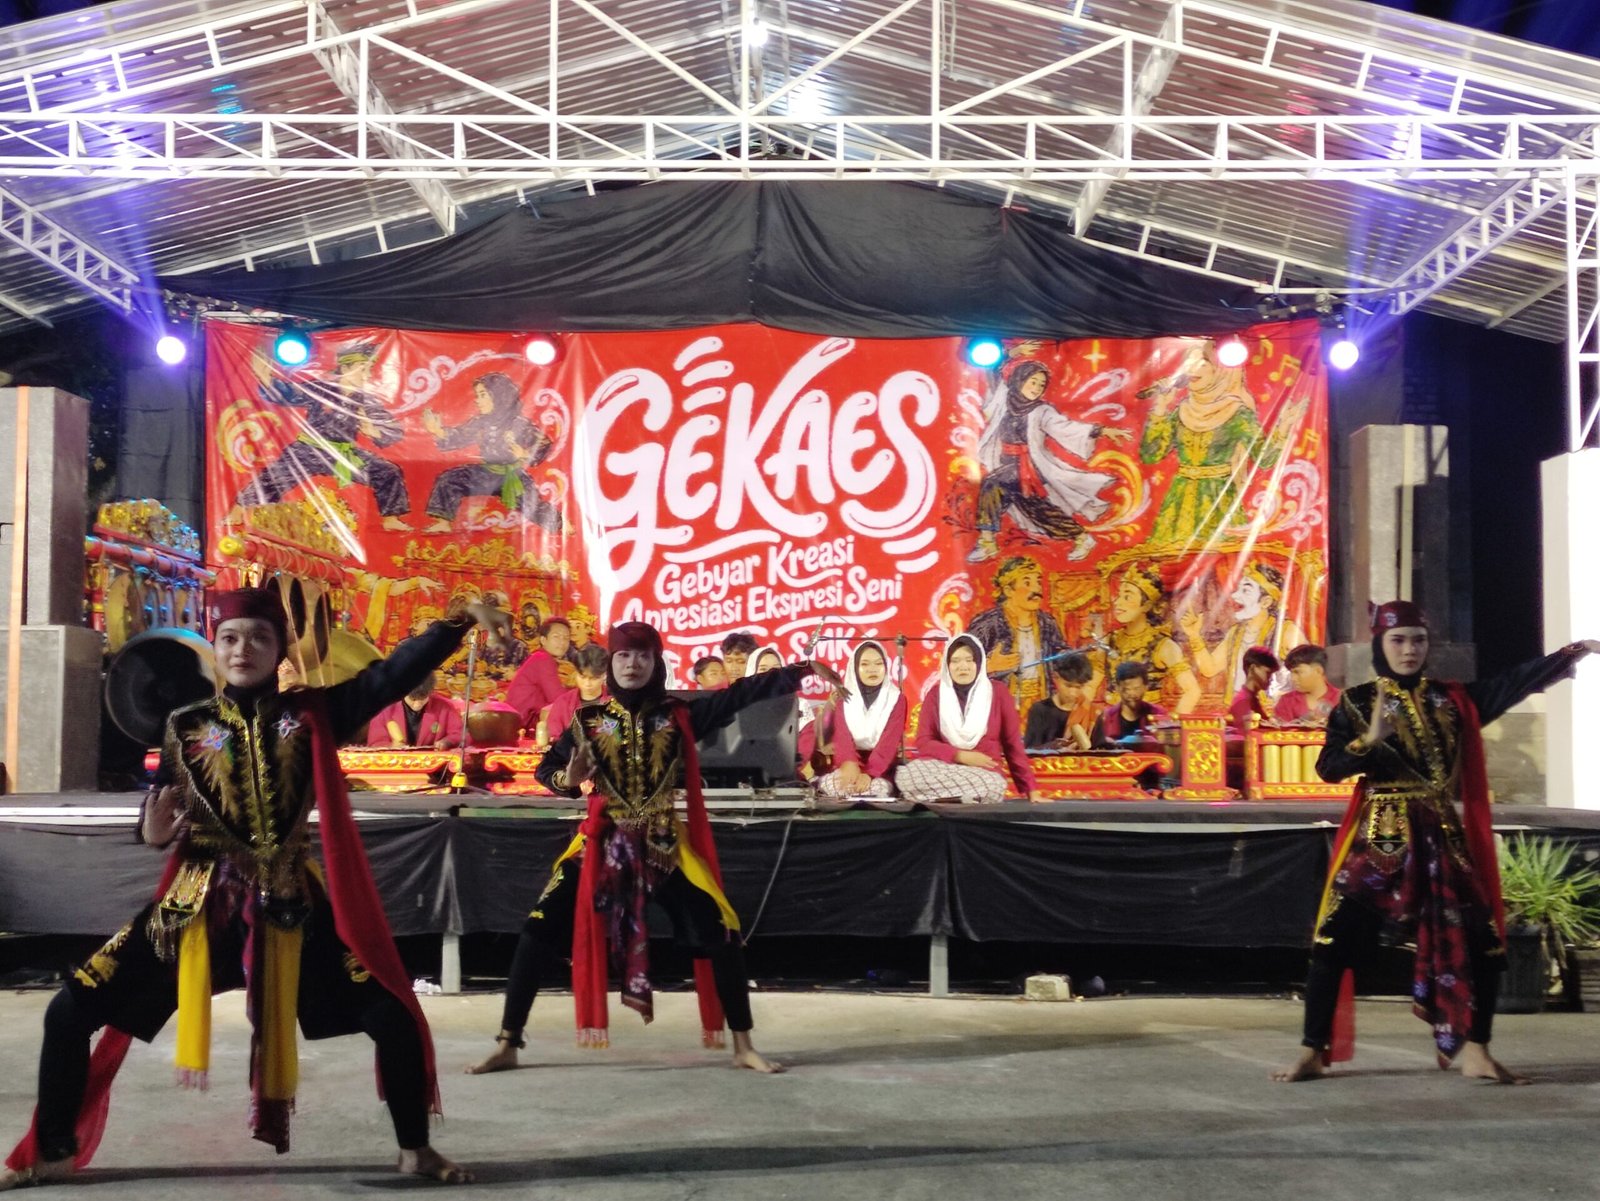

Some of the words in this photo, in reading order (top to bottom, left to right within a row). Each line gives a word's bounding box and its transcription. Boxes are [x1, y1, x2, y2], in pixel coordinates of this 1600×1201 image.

[573, 338, 940, 592] GEKAES
[654, 554, 762, 604] Gebyar
[768, 535, 854, 588] Kreasi
[747, 581, 843, 622] Ekspresi
[845, 566, 903, 612] Seni
